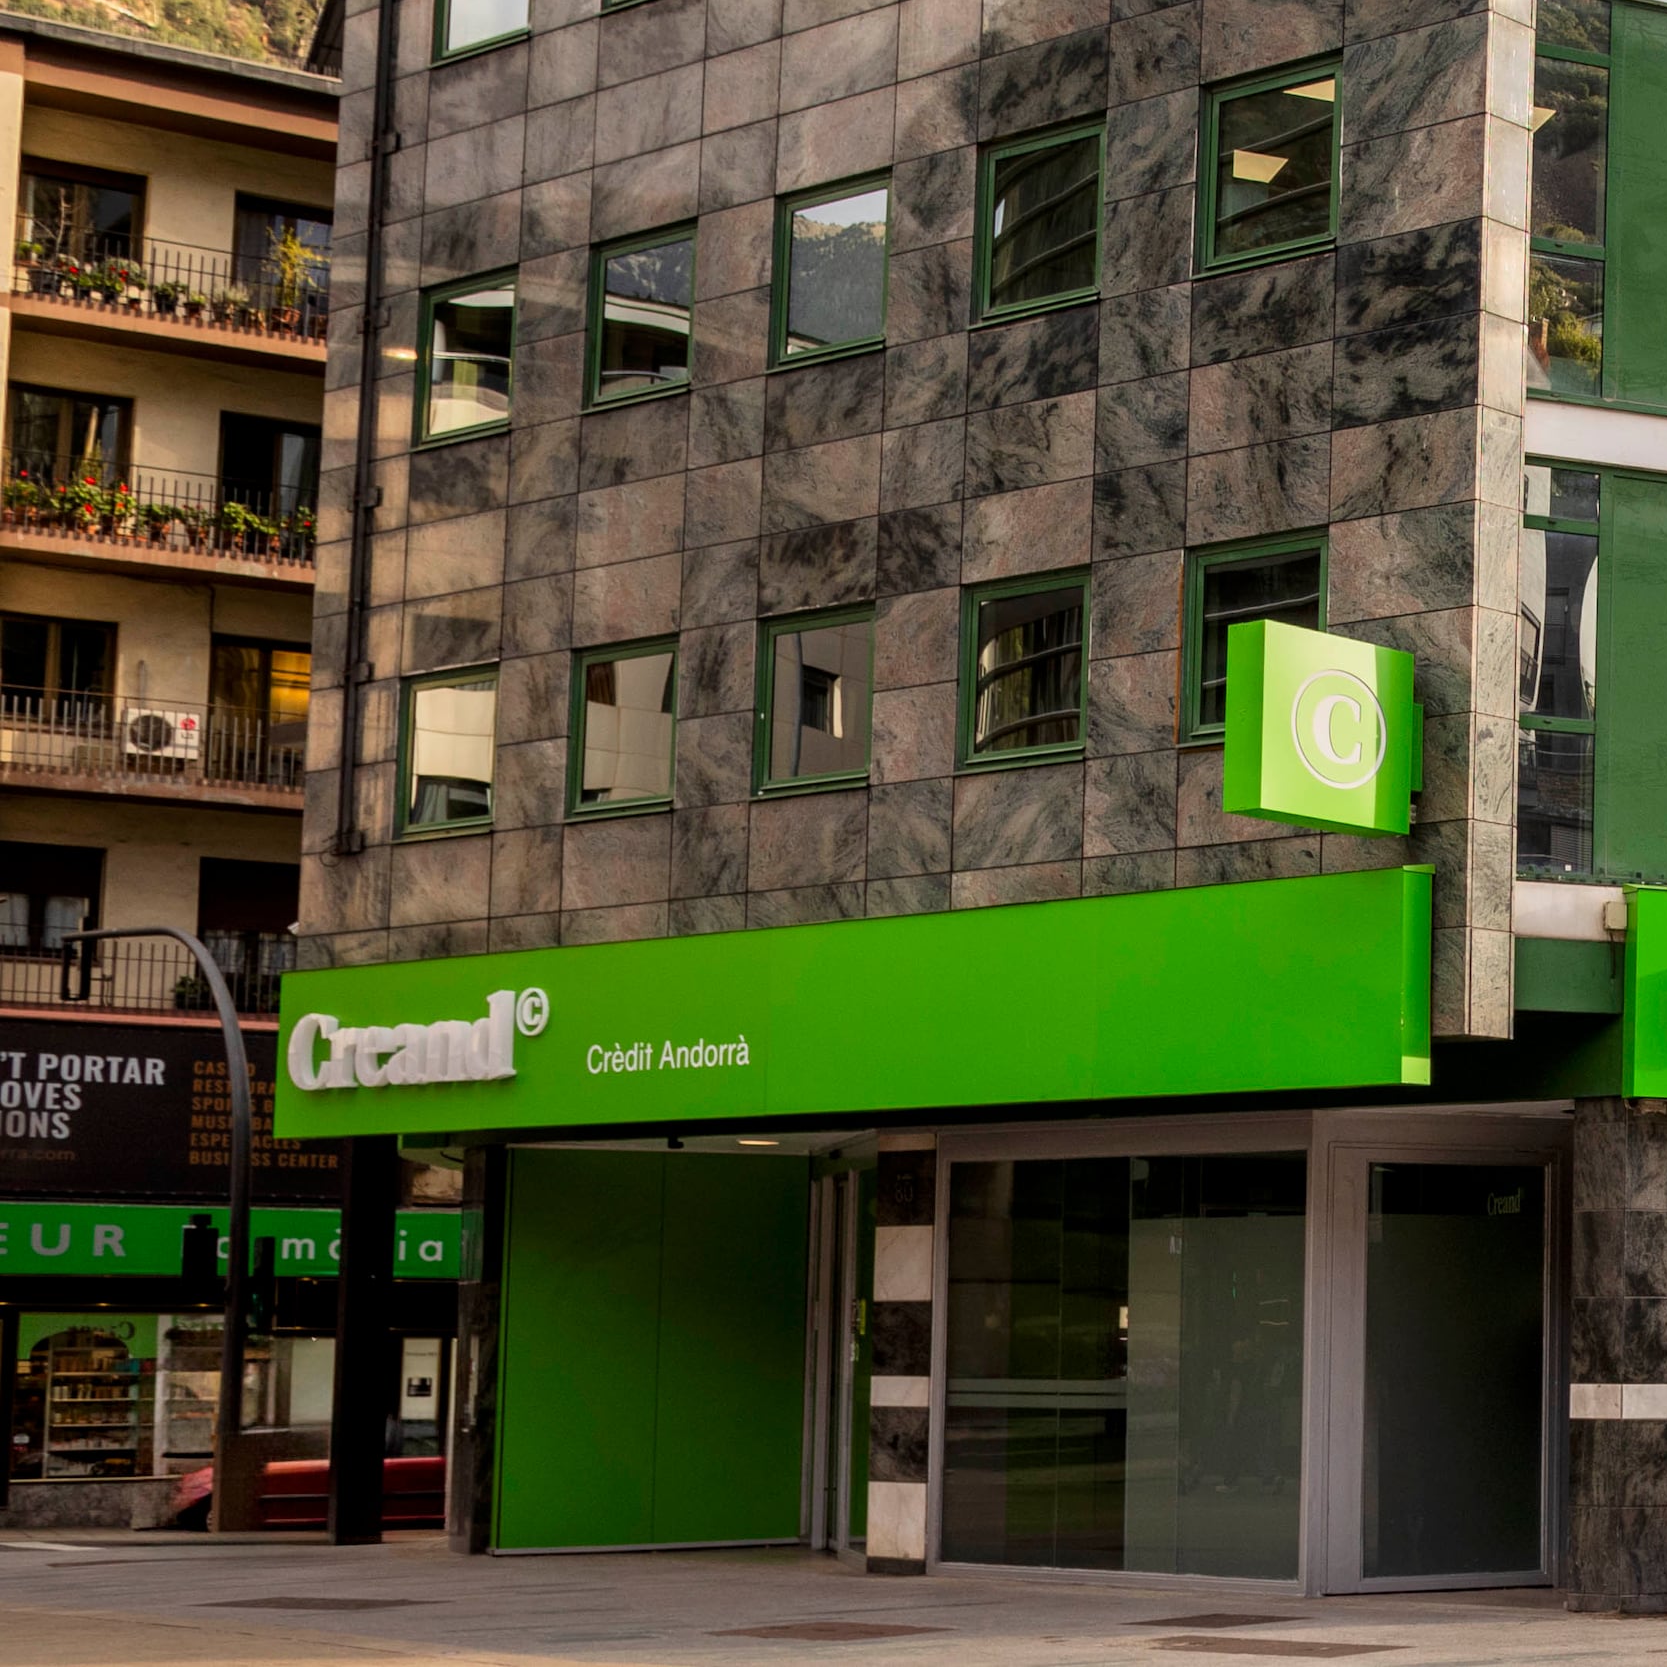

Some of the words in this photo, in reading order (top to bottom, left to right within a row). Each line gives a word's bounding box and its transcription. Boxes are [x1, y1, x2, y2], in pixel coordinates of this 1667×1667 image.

[587, 1042, 652, 1075] Crèdit
[659, 1035, 750, 1071] Andorrà
[38, 1052, 165, 1085] PORTAR
[193, 1060, 256, 1078] CASO
[192, 1096, 257, 1113] SPOS
[190, 1132, 302, 1150] ESPEACLES
[189, 1150, 271, 1167] BUSISS
[278, 1152, 338, 1169] CENTER
